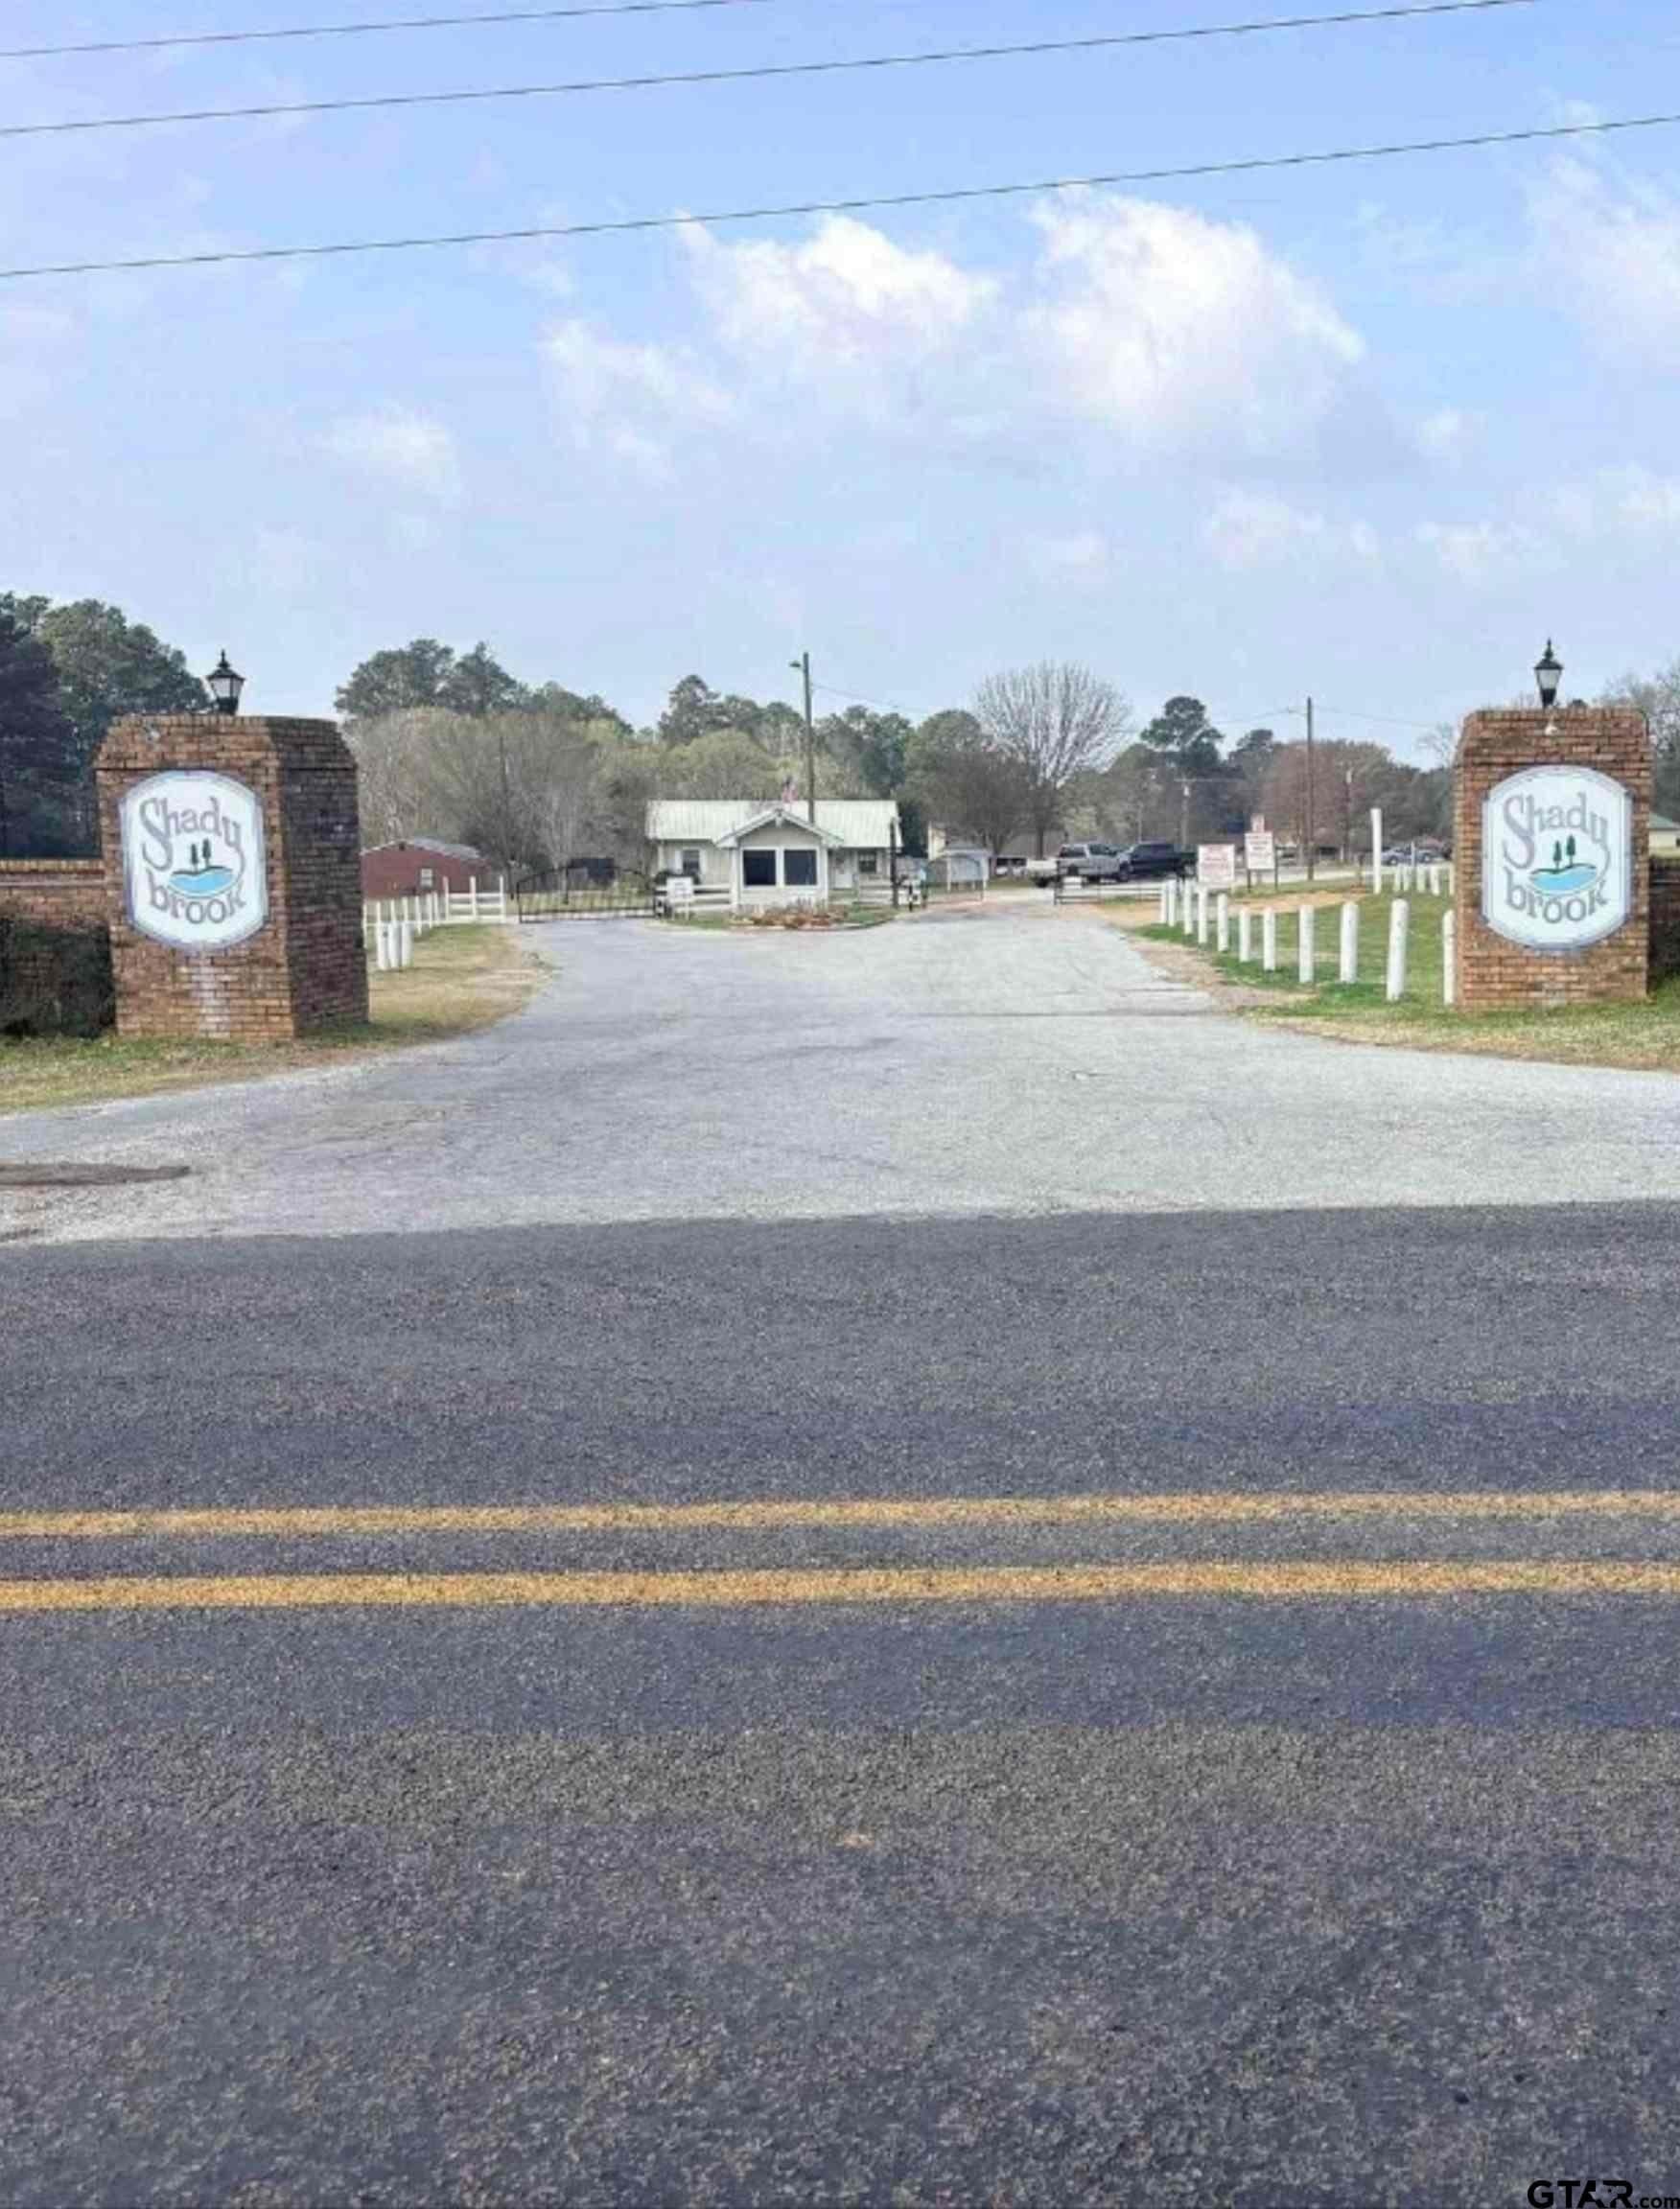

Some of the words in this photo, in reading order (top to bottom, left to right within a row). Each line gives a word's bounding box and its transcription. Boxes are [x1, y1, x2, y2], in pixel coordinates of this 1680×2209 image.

[139, 795, 245, 878] Shady
[1503, 791, 1611, 877] Shady
[146, 867, 246, 924] brook
[1504, 866, 1608, 924] brook
